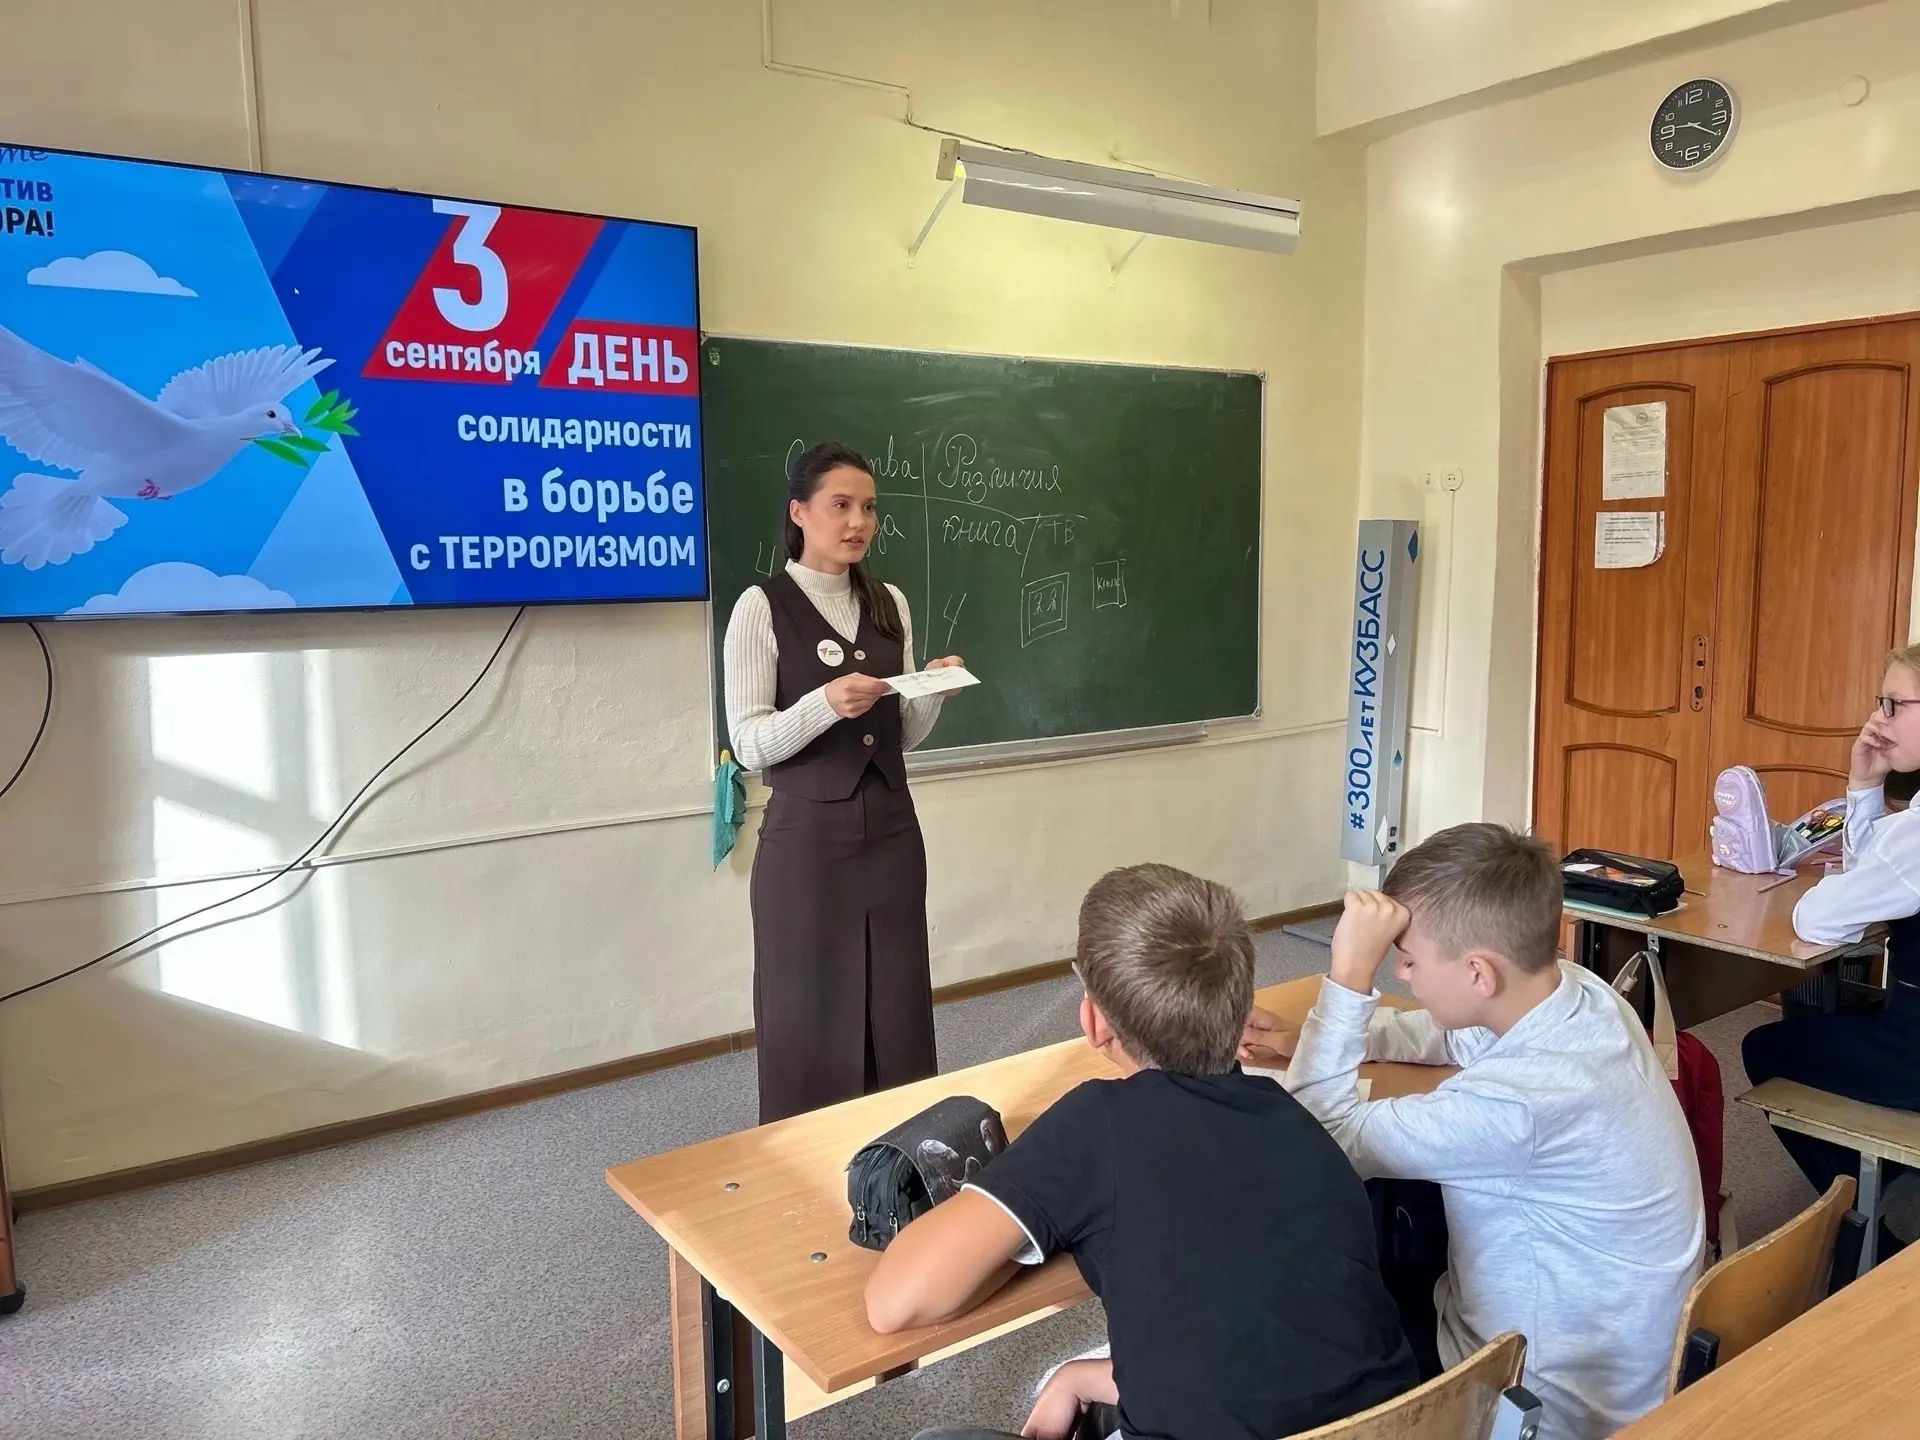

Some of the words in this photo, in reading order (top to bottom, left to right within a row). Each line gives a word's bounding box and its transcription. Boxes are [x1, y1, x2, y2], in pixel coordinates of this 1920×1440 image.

[1677, 99, 1683, 108] 11
[1685, 88, 1703, 105] 12
[1715, 98, 1724, 108] 2
[1665, 112, 1675, 122] 10
[1711, 109, 1727, 126] 3
[1660, 124, 1675, 140] 9
[1665, 142, 1673, 151] 8
[1685, 145, 1700, 161] 6
[1703, 142, 1712, 152] 5
[0, 206, 55, 237] РА!
[432, 199, 509, 332] 3
[385, 339, 541, 381] сентября
[567, 332, 689, 386] ДЕНЬ
[457, 413, 692, 453] солидарности
[503, 477, 528, 513] в
[541, 467, 694, 523] борьбе
[410, 543, 431, 571] с
[439, 535, 695, 570] ТЕРРОРИЗМОМ
